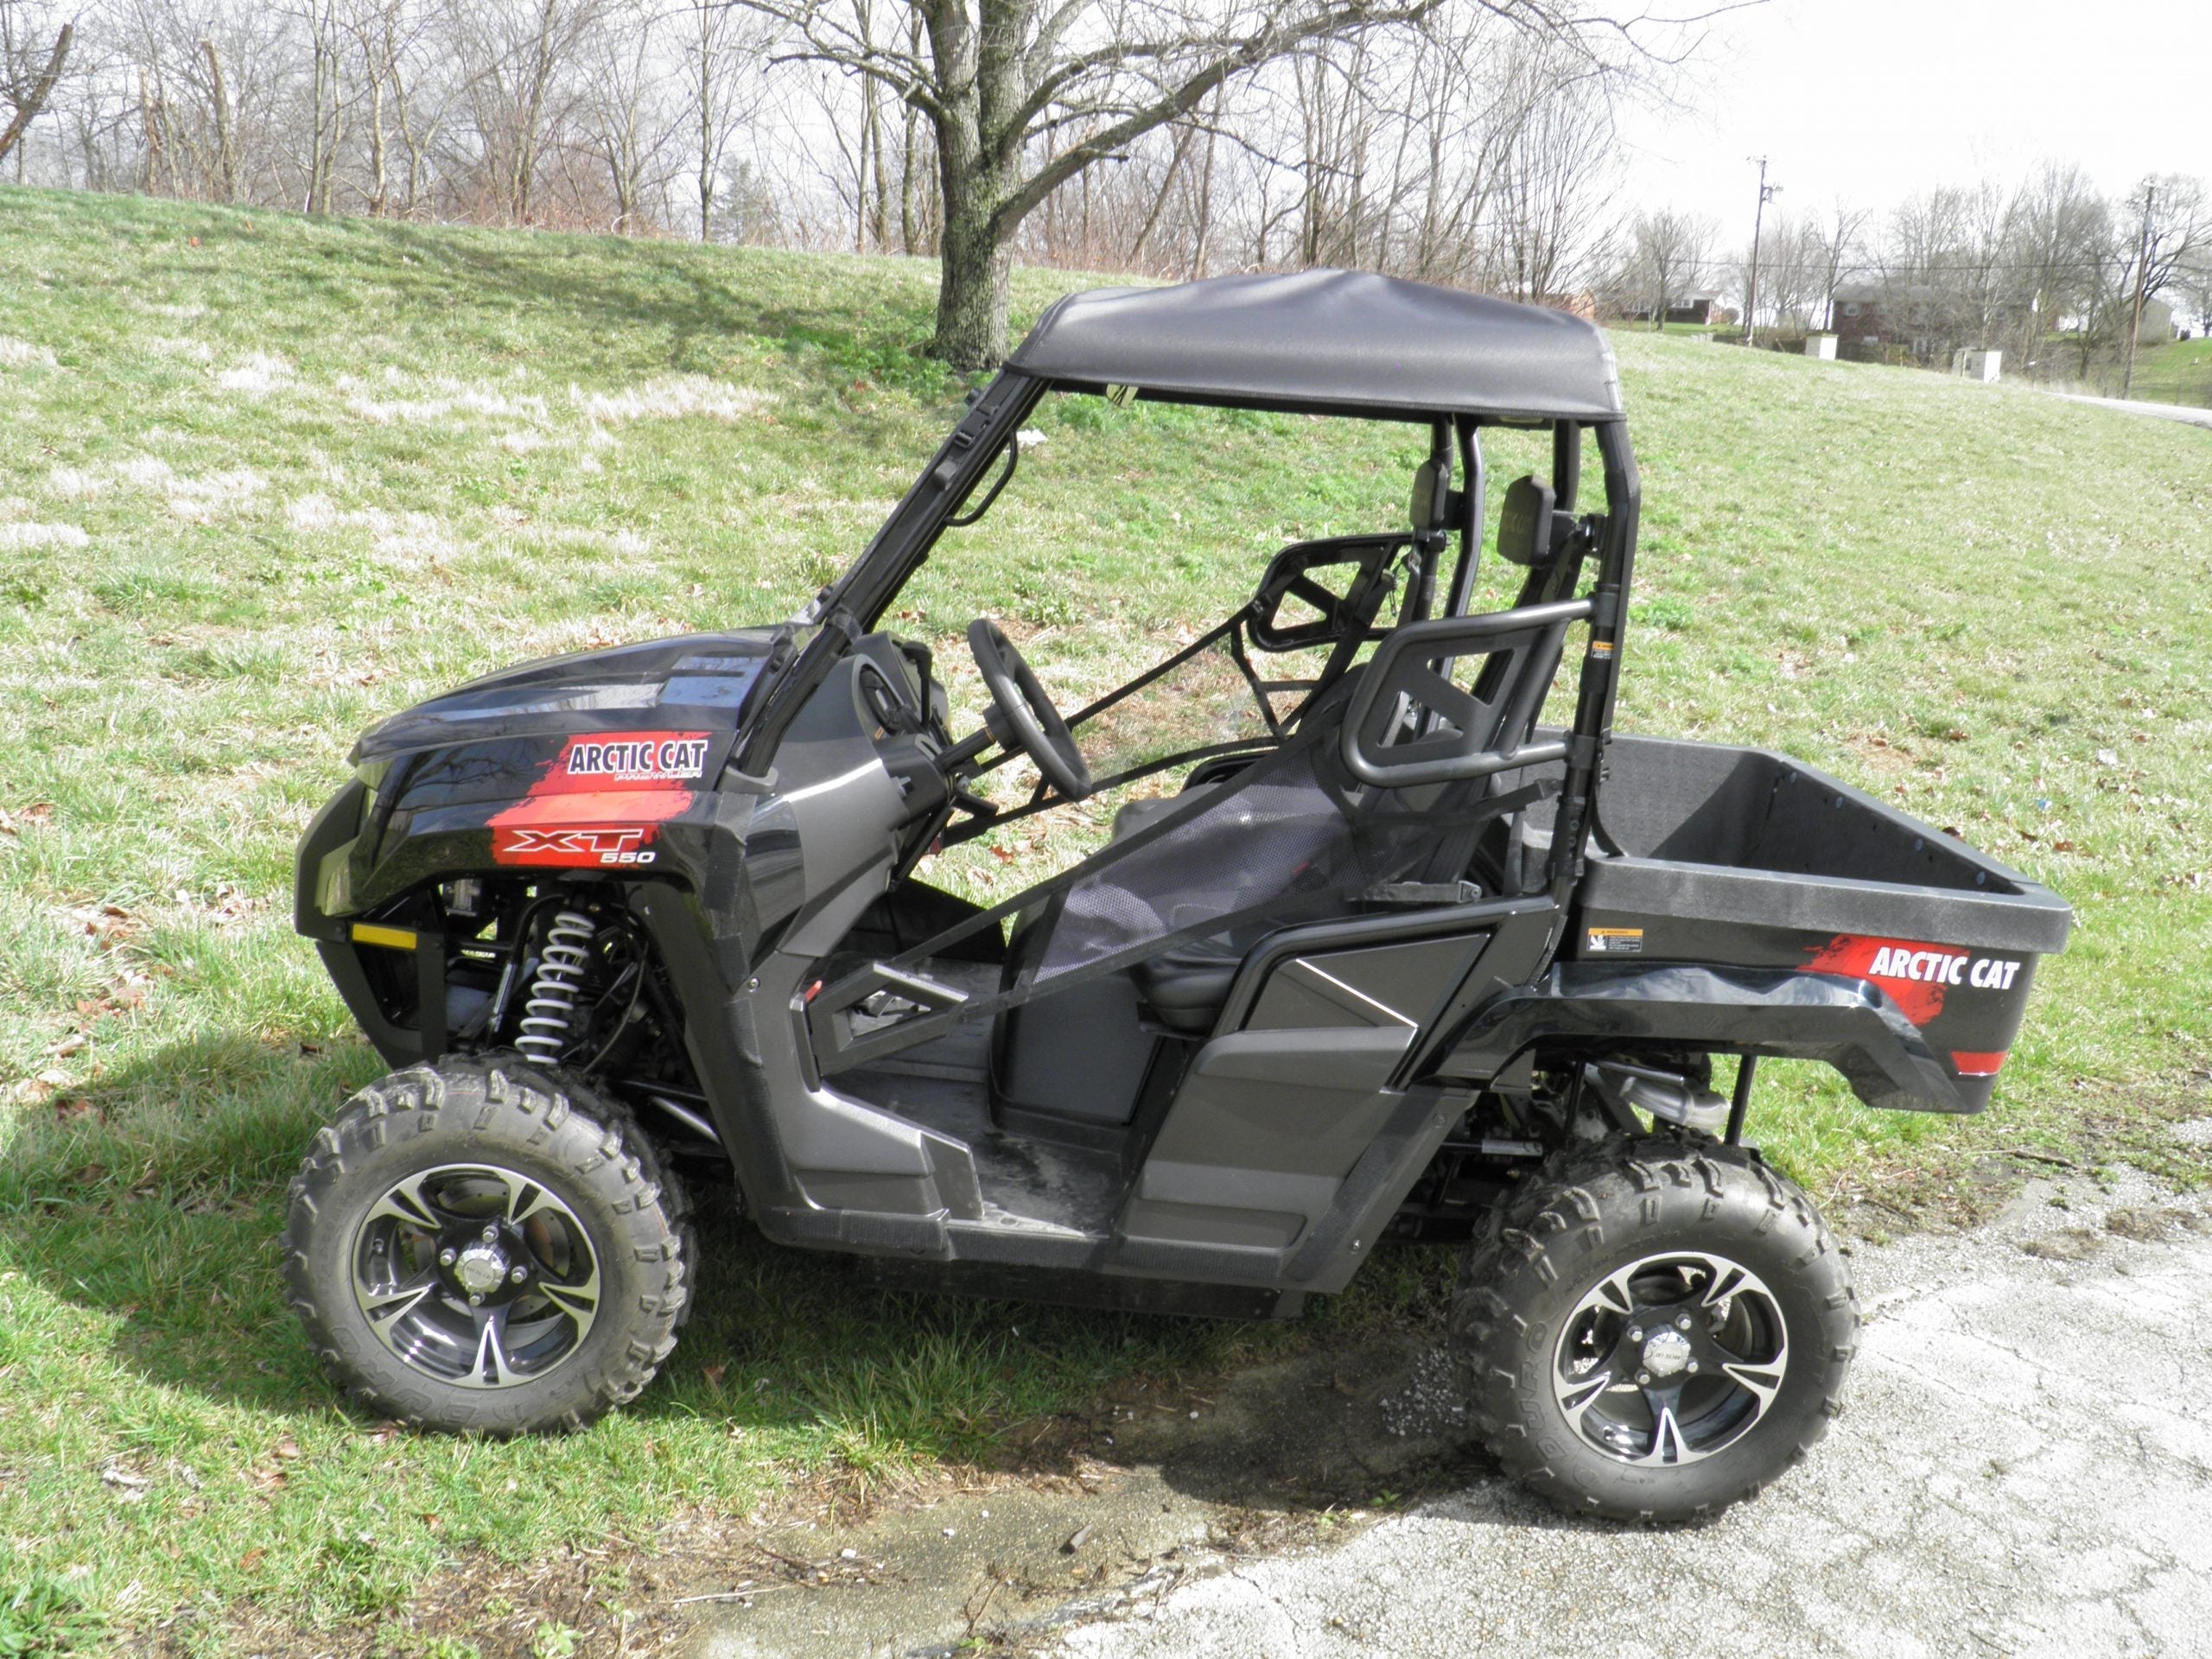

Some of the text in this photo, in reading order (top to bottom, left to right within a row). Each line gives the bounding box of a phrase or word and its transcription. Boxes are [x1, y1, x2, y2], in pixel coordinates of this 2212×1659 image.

[567, 740, 708, 774] ARCTIC CAT
[502, 829, 644, 852] XT
[600, 851, 656, 863] 550
[1869, 947, 2021, 989] ARCTIC CAT
